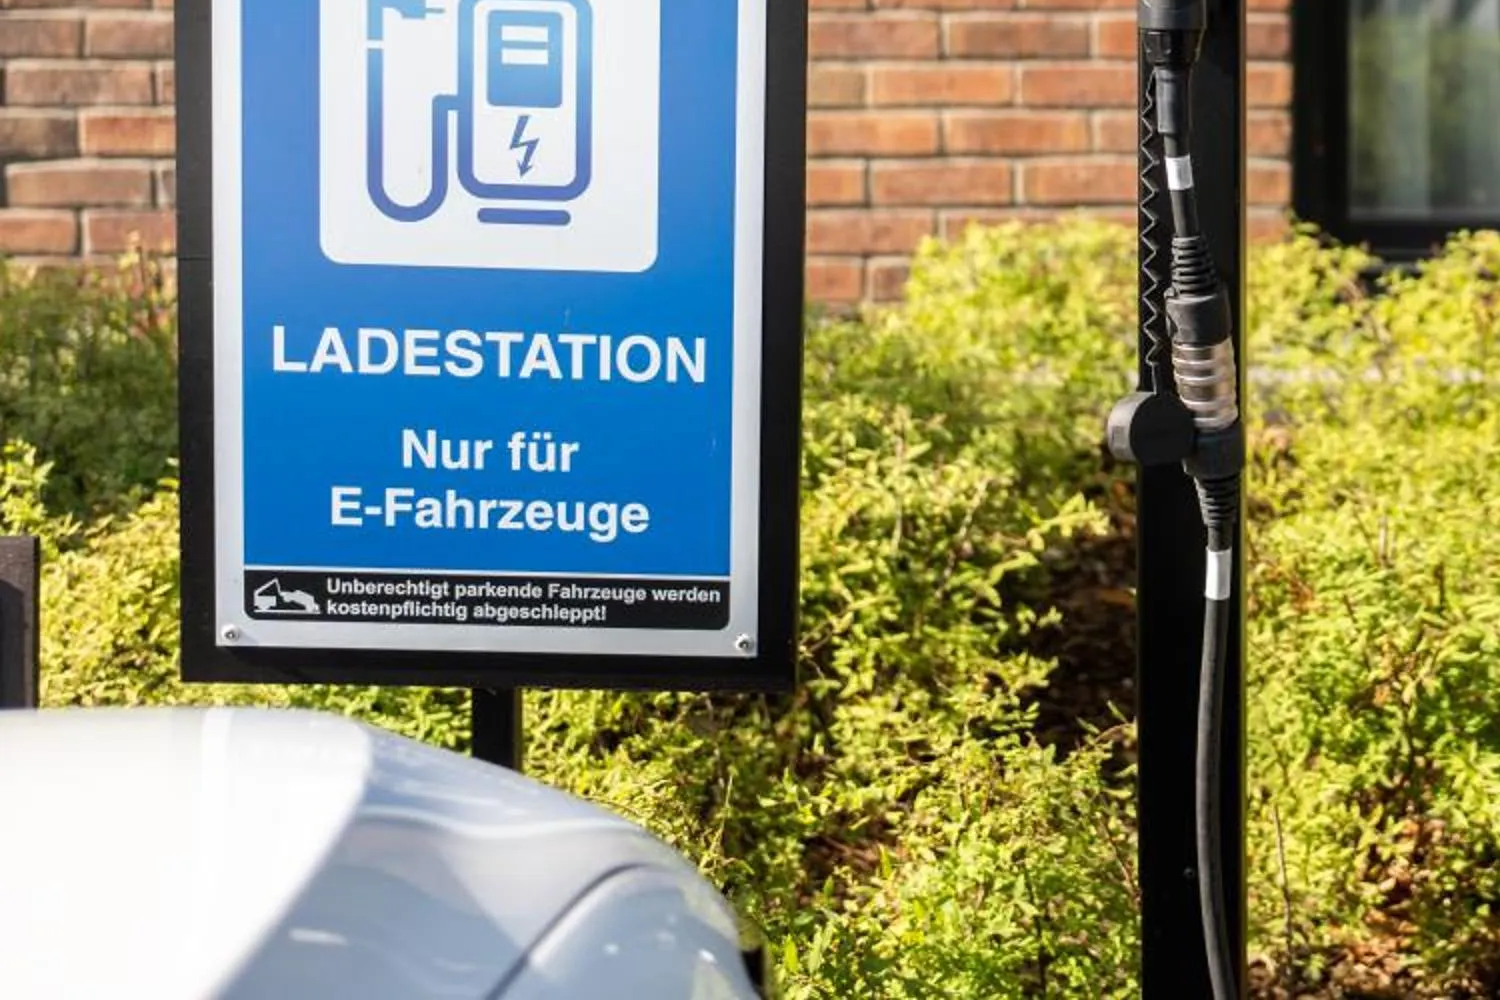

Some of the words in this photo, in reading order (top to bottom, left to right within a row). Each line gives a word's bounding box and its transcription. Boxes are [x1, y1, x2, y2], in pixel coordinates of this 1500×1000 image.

[272, 324, 706, 383] LADESTATION
[402, 428, 493, 470] Nur
[507, 431, 580, 473] für
[331, 485, 650, 543] E-Fahrzeuge
[326, 577, 449, 598] Unberechtigt
[455, 581, 543, 598] parkende
[548, 583, 646, 604] Fahrzeuge
[651, 586, 721, 603] werden
[326, 600, 467, 620] kostenpflichtig
[473, 603, 606, 624] abgeschleppt!
